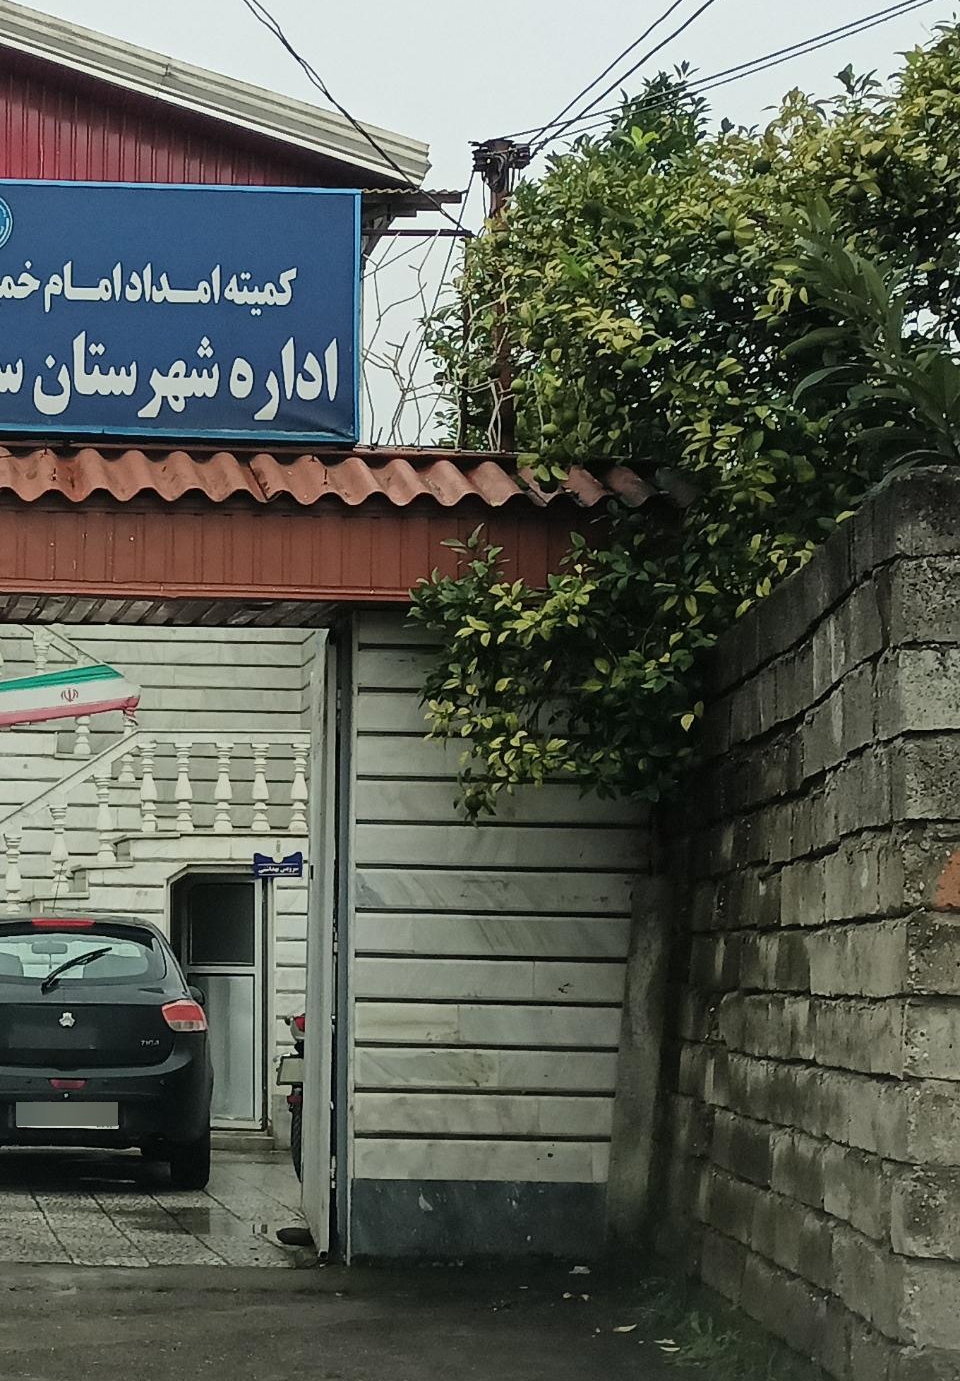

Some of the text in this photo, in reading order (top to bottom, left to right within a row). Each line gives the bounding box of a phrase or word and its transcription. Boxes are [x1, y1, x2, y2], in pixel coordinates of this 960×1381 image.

[44, 260, 122, 313] امام
[124, 262, 221, 305] امداد
[224, 267, 297, 316] کمیته
[33, 330, 220, 418] شهرستان
[229, 336, 338, 421] اداره
